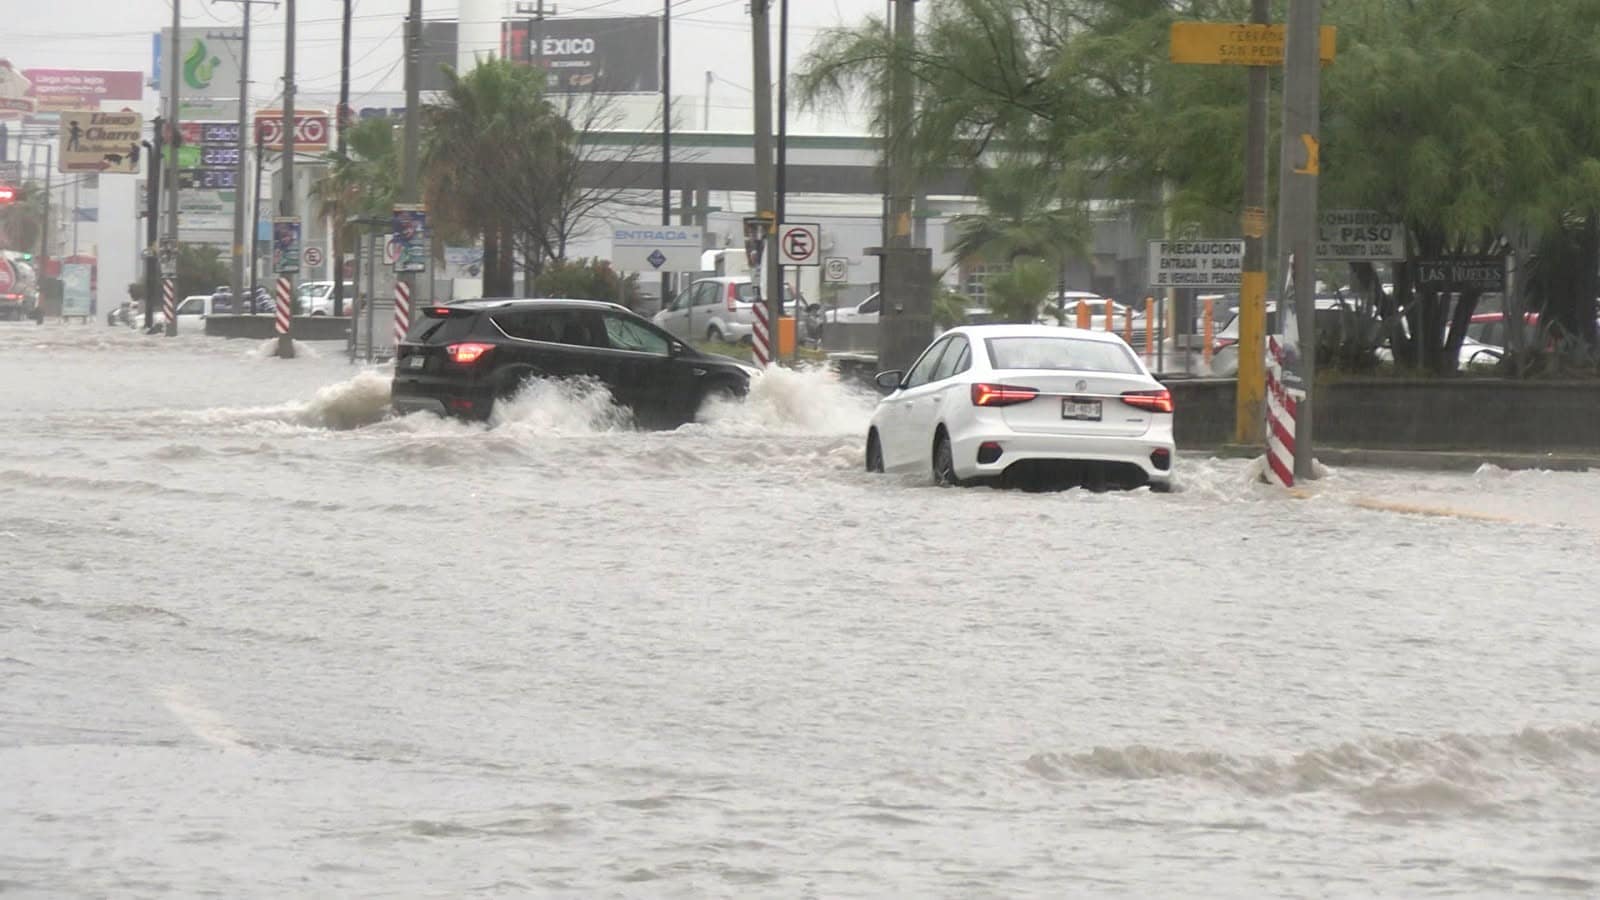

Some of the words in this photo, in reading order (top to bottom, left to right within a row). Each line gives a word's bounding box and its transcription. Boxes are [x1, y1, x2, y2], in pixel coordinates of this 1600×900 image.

[1219, 45, 1247, 56] SAN
[90, 112, 136, 125] Lienzo
[86, 127, 140, 140] Charro
[615, 230, 688, 240] ENTRADA
[1341, 227, 1392, 242] PASO
[1160, 243, 1241, 255] PRECAUCION
[1160, 258, 1197, 270] ENTRADA
[1202, 258, 1208, 270] Y
[1211, 258, 1241, 270] SALIDA
[1158, 272, 1168, 284] DE
[1171, 272, 1208, 284] VEHICULOS
[1419, 266, 1446, 283] LAS
[1452, 265, 1502, 282] NUECES
